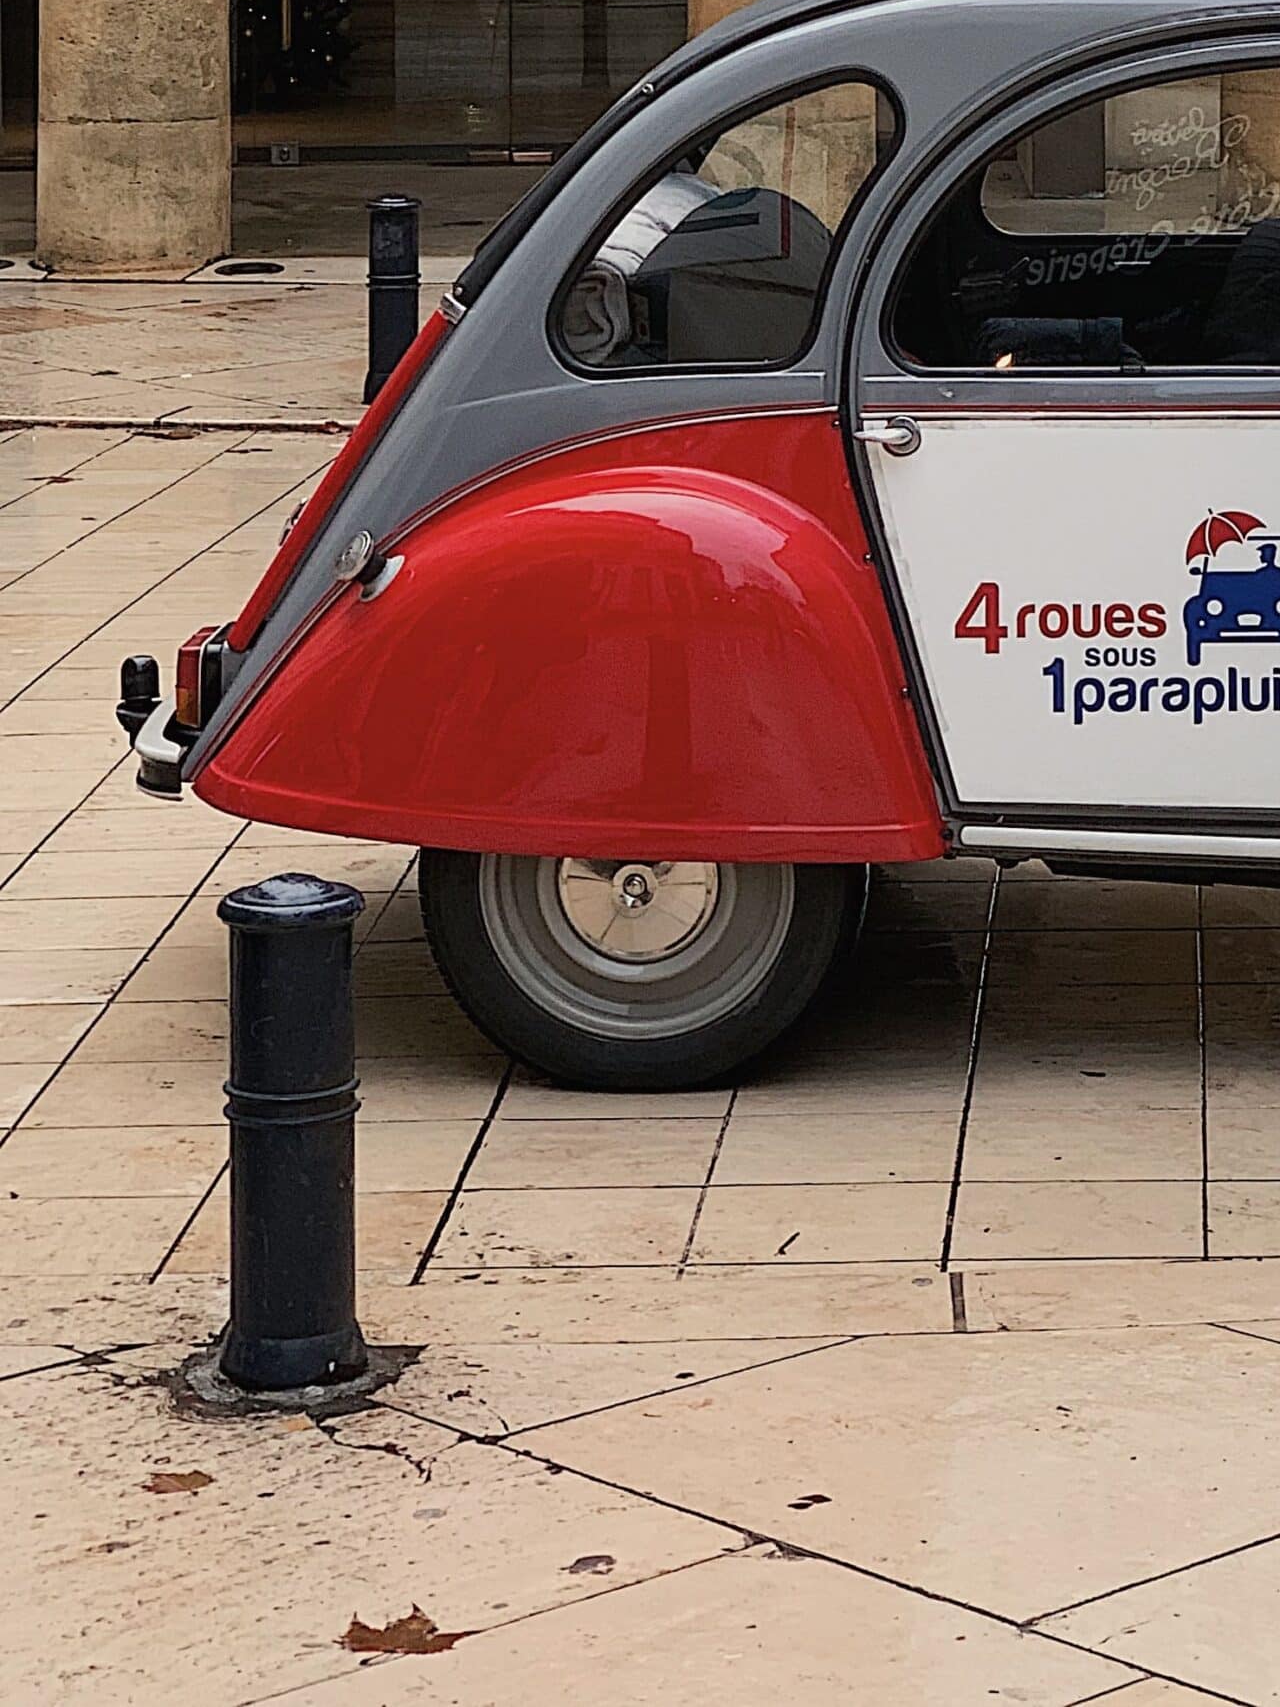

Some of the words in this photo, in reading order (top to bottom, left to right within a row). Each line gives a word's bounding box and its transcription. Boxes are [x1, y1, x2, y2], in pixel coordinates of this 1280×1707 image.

[954, 582, 1008, 654] 4
[1015, 603, 1168, 639] roues
[1084, 647, 1157, 667] sous
